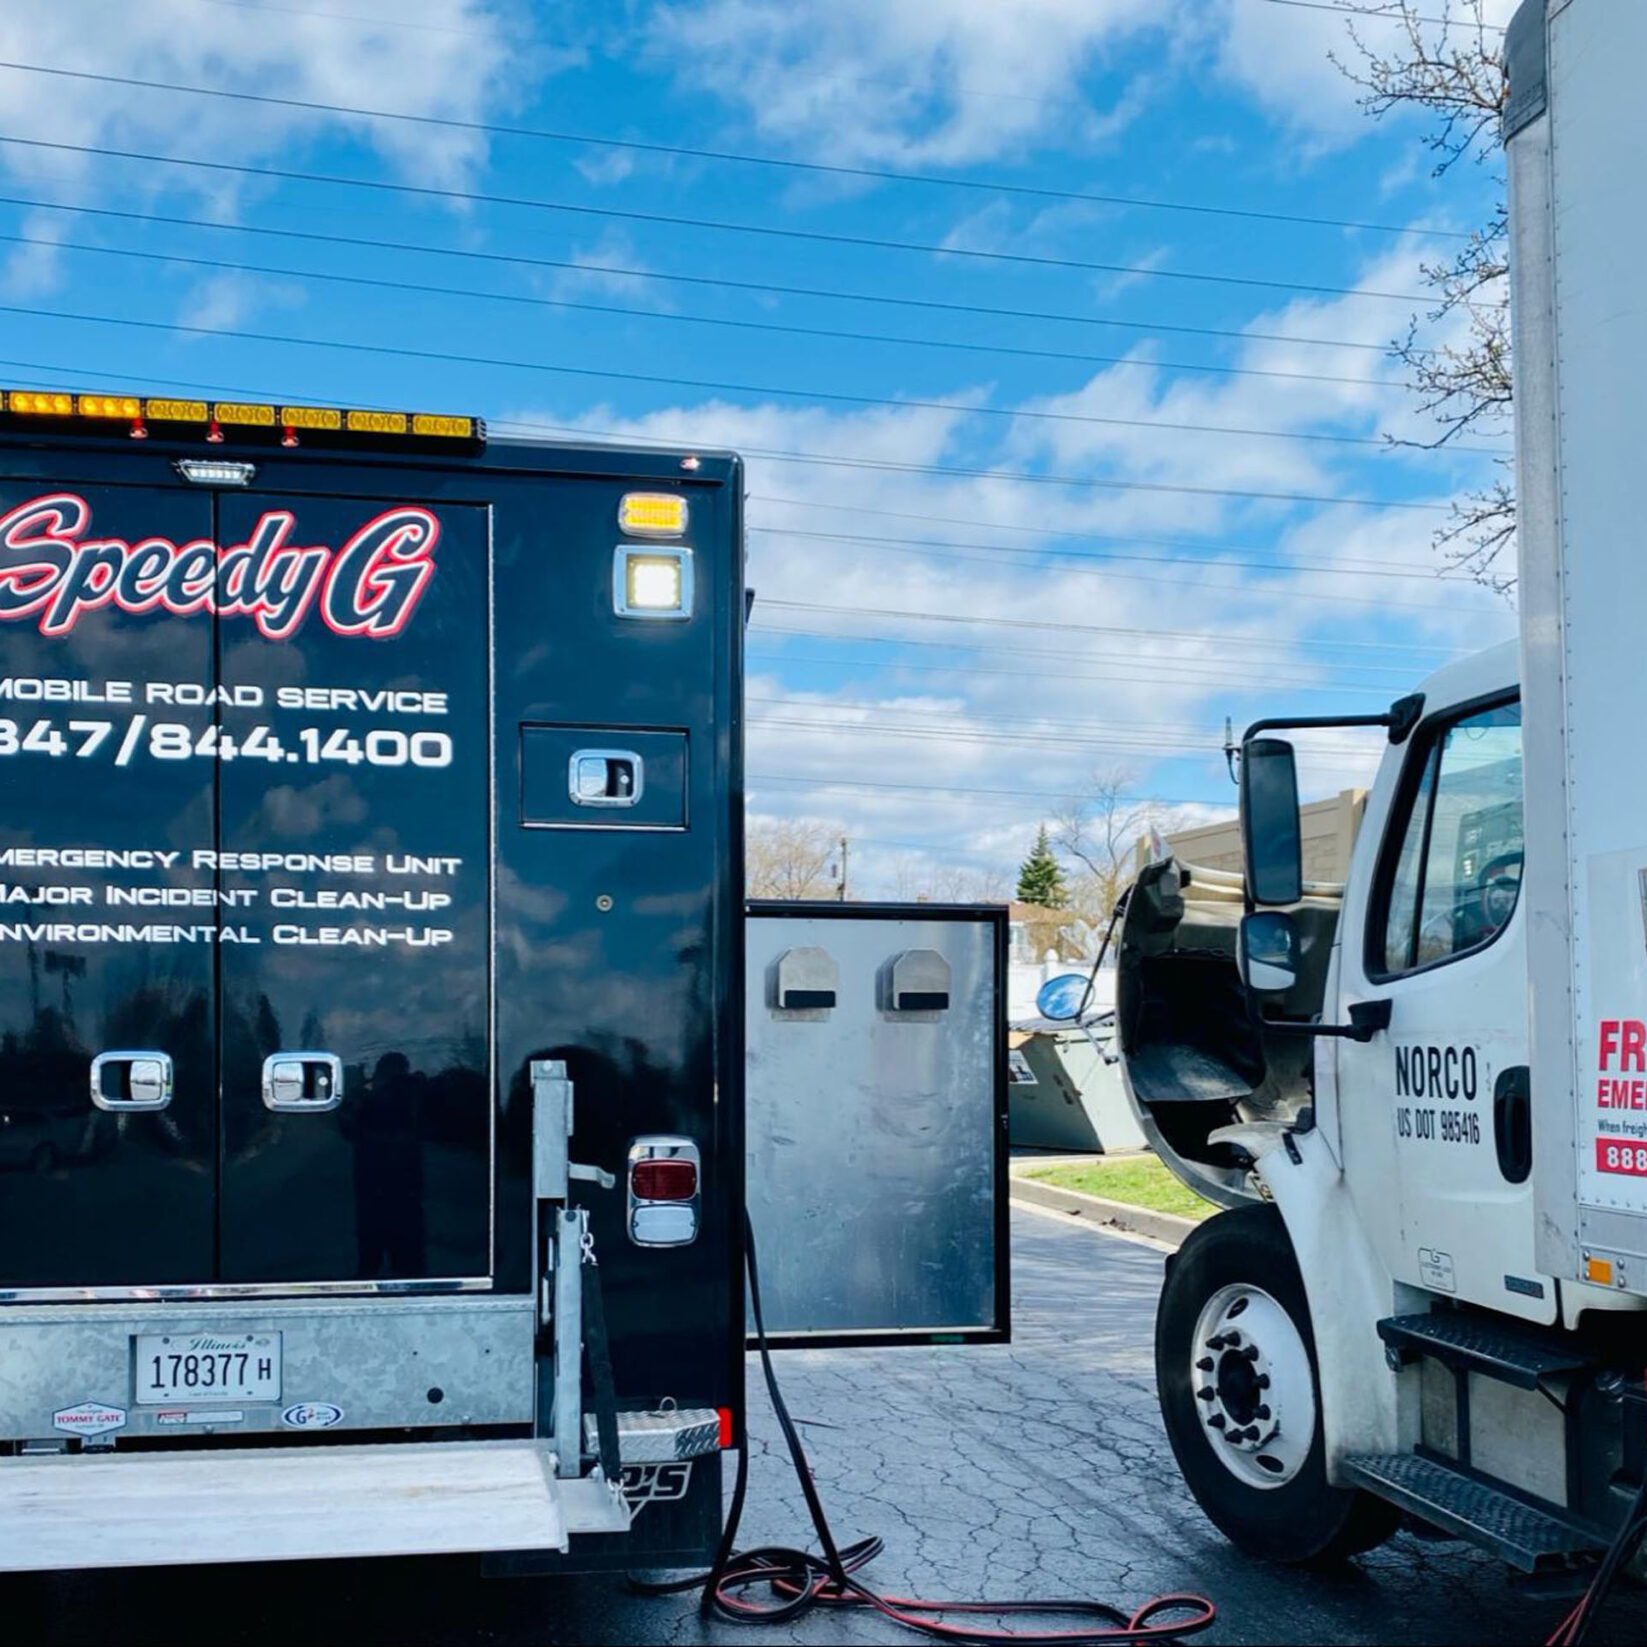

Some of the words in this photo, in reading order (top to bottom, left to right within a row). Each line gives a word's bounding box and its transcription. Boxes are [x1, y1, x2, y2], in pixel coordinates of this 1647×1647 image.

[0, 493, 330, 639] Speedy
[322, 505, 440, 638] G
[146, 683, 263, 706] ROAD
[277, 687, 448, 714] SERVICE
[193, 850, 375, 873] RESPONSE
[386, 855, 462, 875] UNIT
[0, 884, 93, 905] AJOR
[106, 885, 258, 907] INCIDENT
[271, 888, 451, 910] CLEAN-UP
[273, 925, 453, 947] CLEAN-UP
[1395, 1045, 1477, 1101] NORCO
[1597, 1078, 1647, 1110] EME
[1397, 1107, 1412, 1138] US
[1415, 1108, 1436, 1140] DOT
[1441, 1110, 1480, 1145] 985416
[189, 1338, 247, 1351] Illinois
[150, 1353, 249, 1389] 178377
[258, 1357, 272, 1381] H
[56, 1414, 94, 1424] TOMMY
[97, 1413, 121, 1423] GATE
